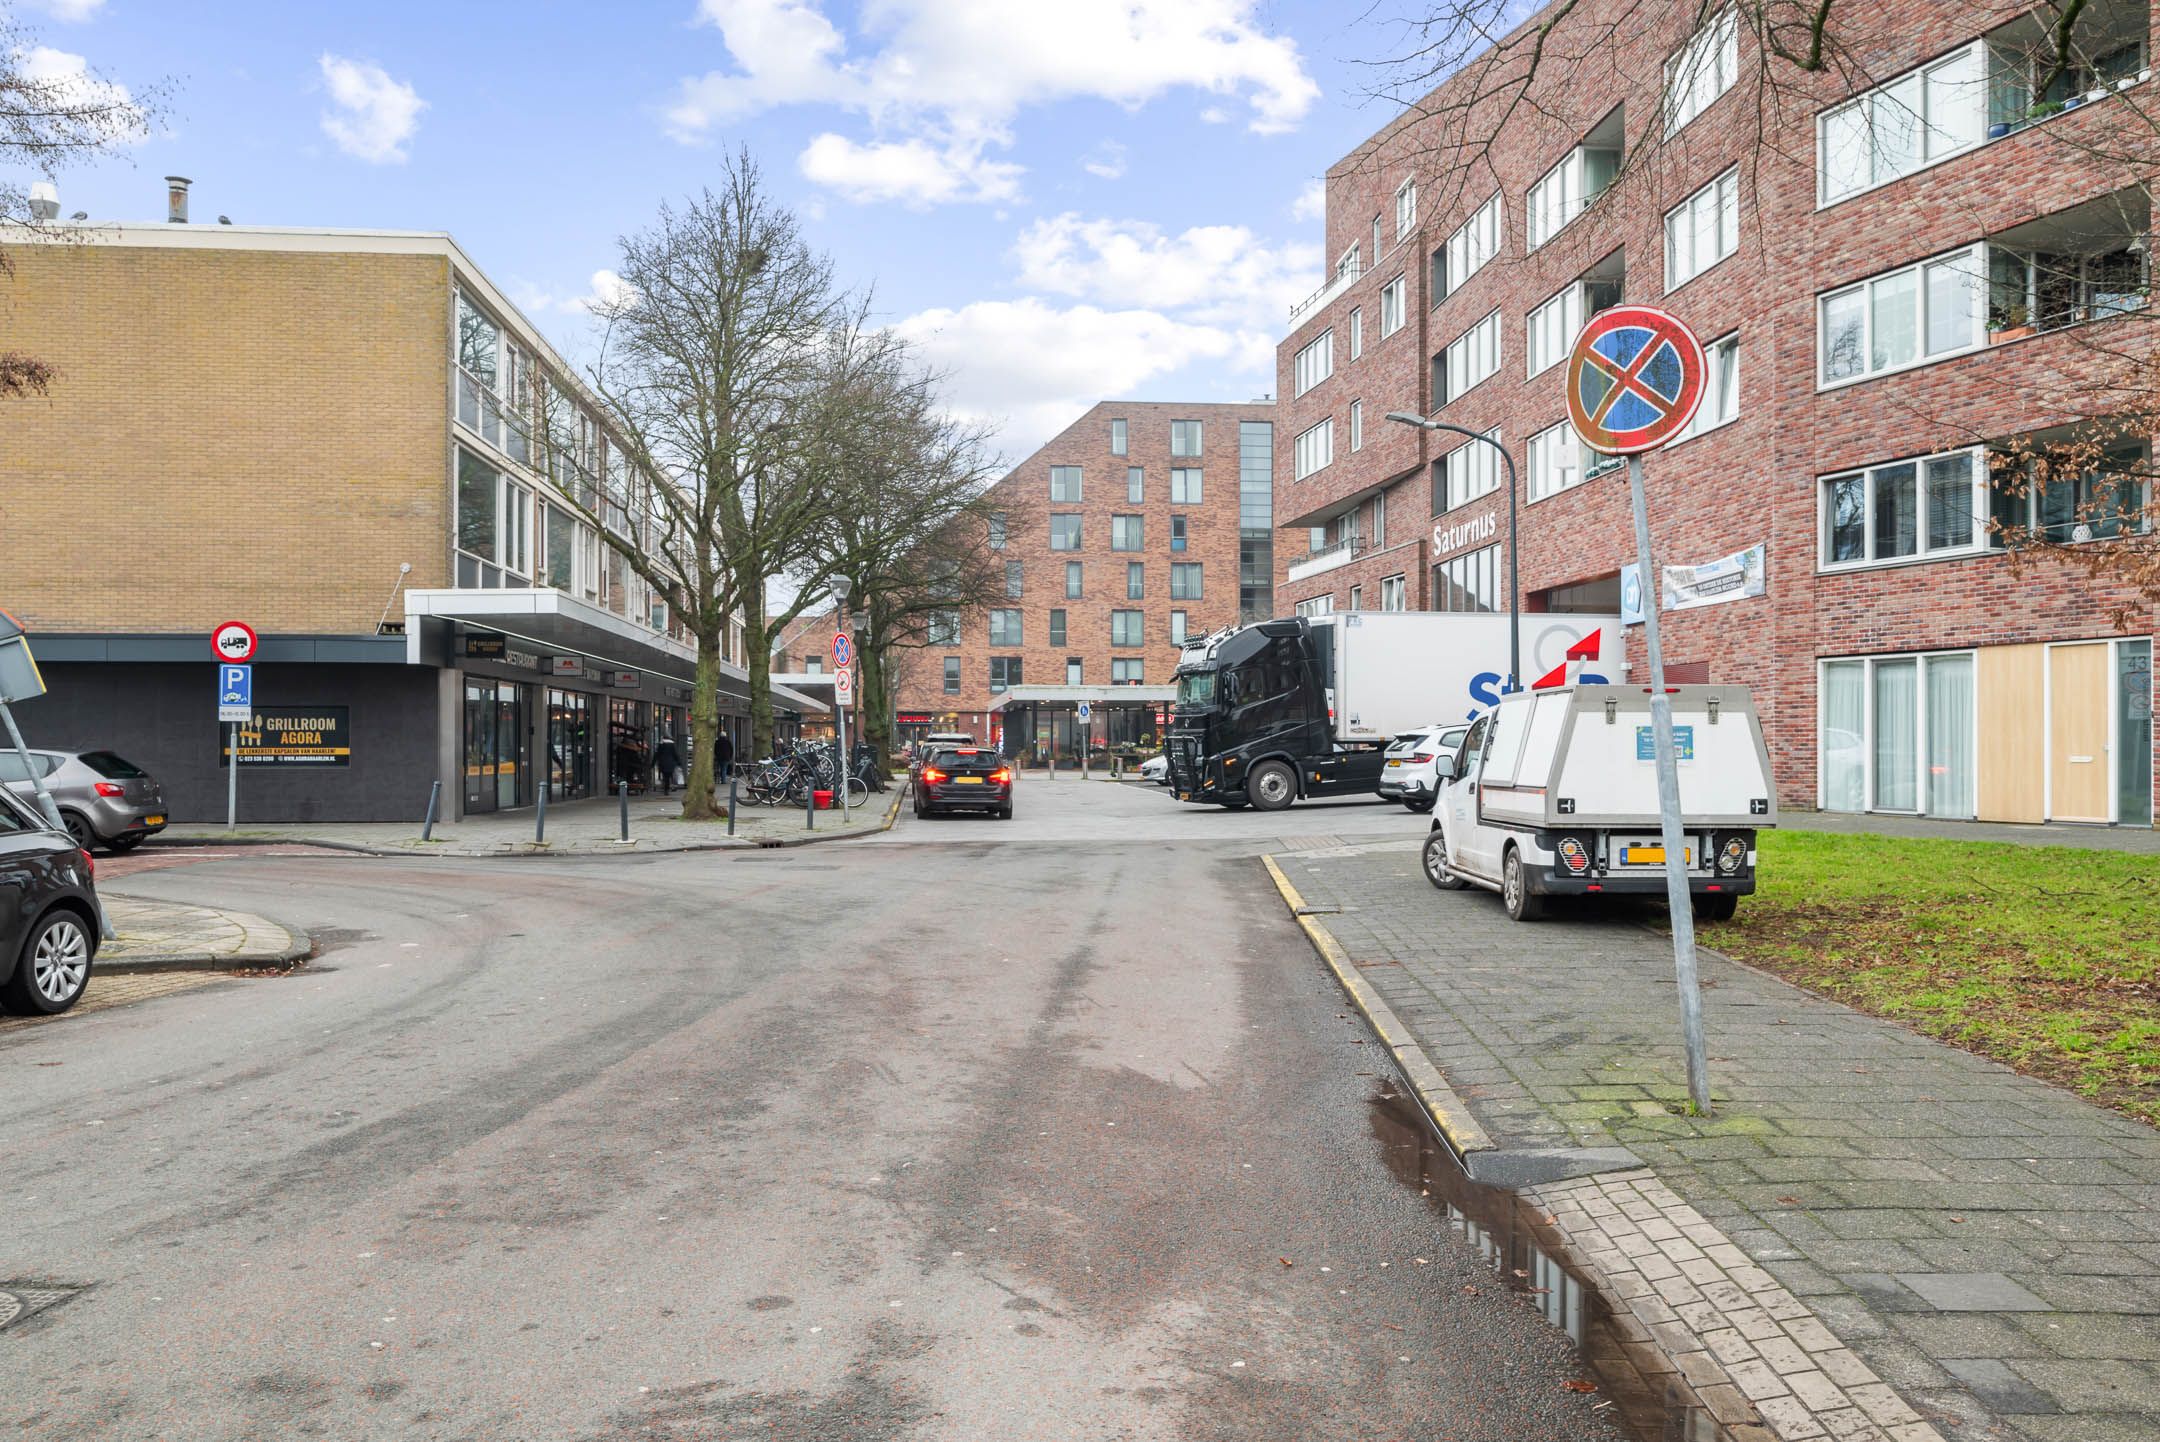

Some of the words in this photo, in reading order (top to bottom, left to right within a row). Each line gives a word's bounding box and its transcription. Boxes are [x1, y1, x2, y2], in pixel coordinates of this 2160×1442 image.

[1433, 511, 1496, 557] Saturnus
[2128, 655, 2147, 671] 43
[227, 668, 244, 689] P
[266, 718, 336, 731] GRILLROOM
[281, 731, 321, 744] AGORA
